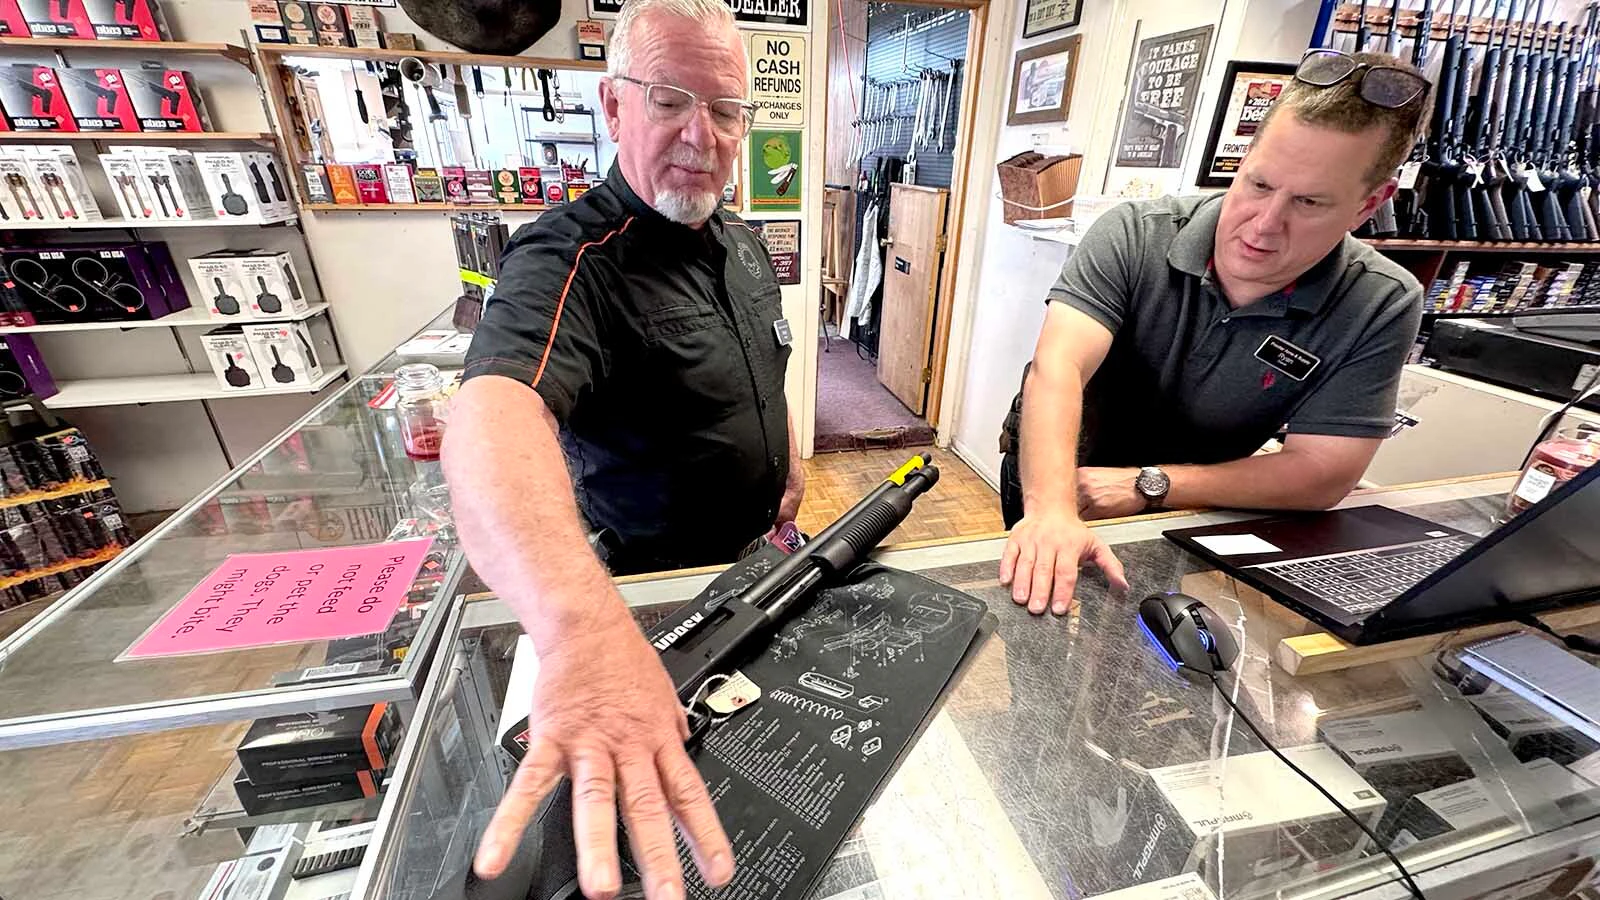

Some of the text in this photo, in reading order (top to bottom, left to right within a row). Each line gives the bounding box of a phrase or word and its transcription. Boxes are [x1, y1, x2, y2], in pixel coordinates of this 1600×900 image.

[730, 0, 800, 18] DEALER
[767, 40, 790, 56] NO
[1148, 40, 1196, 60] IT TAKES
[756, 59, 800, 75] CASH
[1141, 54, 1199, 75] COURAGE
[755, 77, 801, 93] REFUNDS
[1149, 73, 1182, 90] TO BE
[754, 101, 801, 111] EXCHANGES
[1140, 87, 1185, 109] FREE
[769, 110, 789, 120] ONLY
[266, 563, 324, 625] or pet the
[317, 563, 361, 614] not feed
[358, 555, 405, 613] Please do
[171, 568, 248, 638] might bite.
[215, 565, 289, 632] dogs. They
